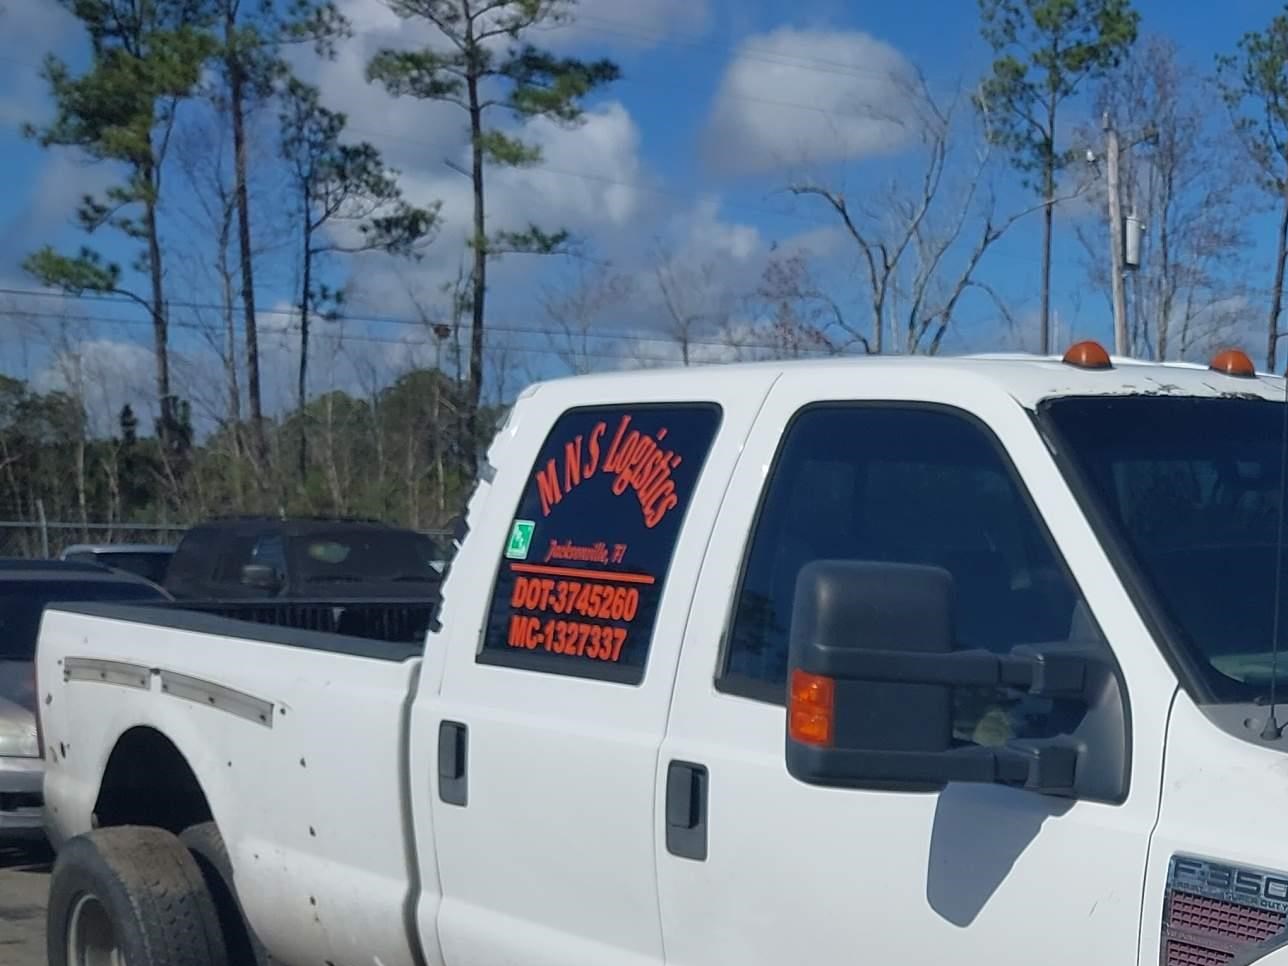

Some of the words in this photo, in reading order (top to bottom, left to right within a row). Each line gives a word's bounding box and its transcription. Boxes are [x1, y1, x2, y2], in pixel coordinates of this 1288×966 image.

[535, 458, 563, 517] M
[564, 434, 583, 494] N
[584, 421, 607, 479] S
[602, 414, 682, 528] Logistics
[511, 576, 639, 621] DOT-3745260
[508, 614, 627, 661] MC-1327337
